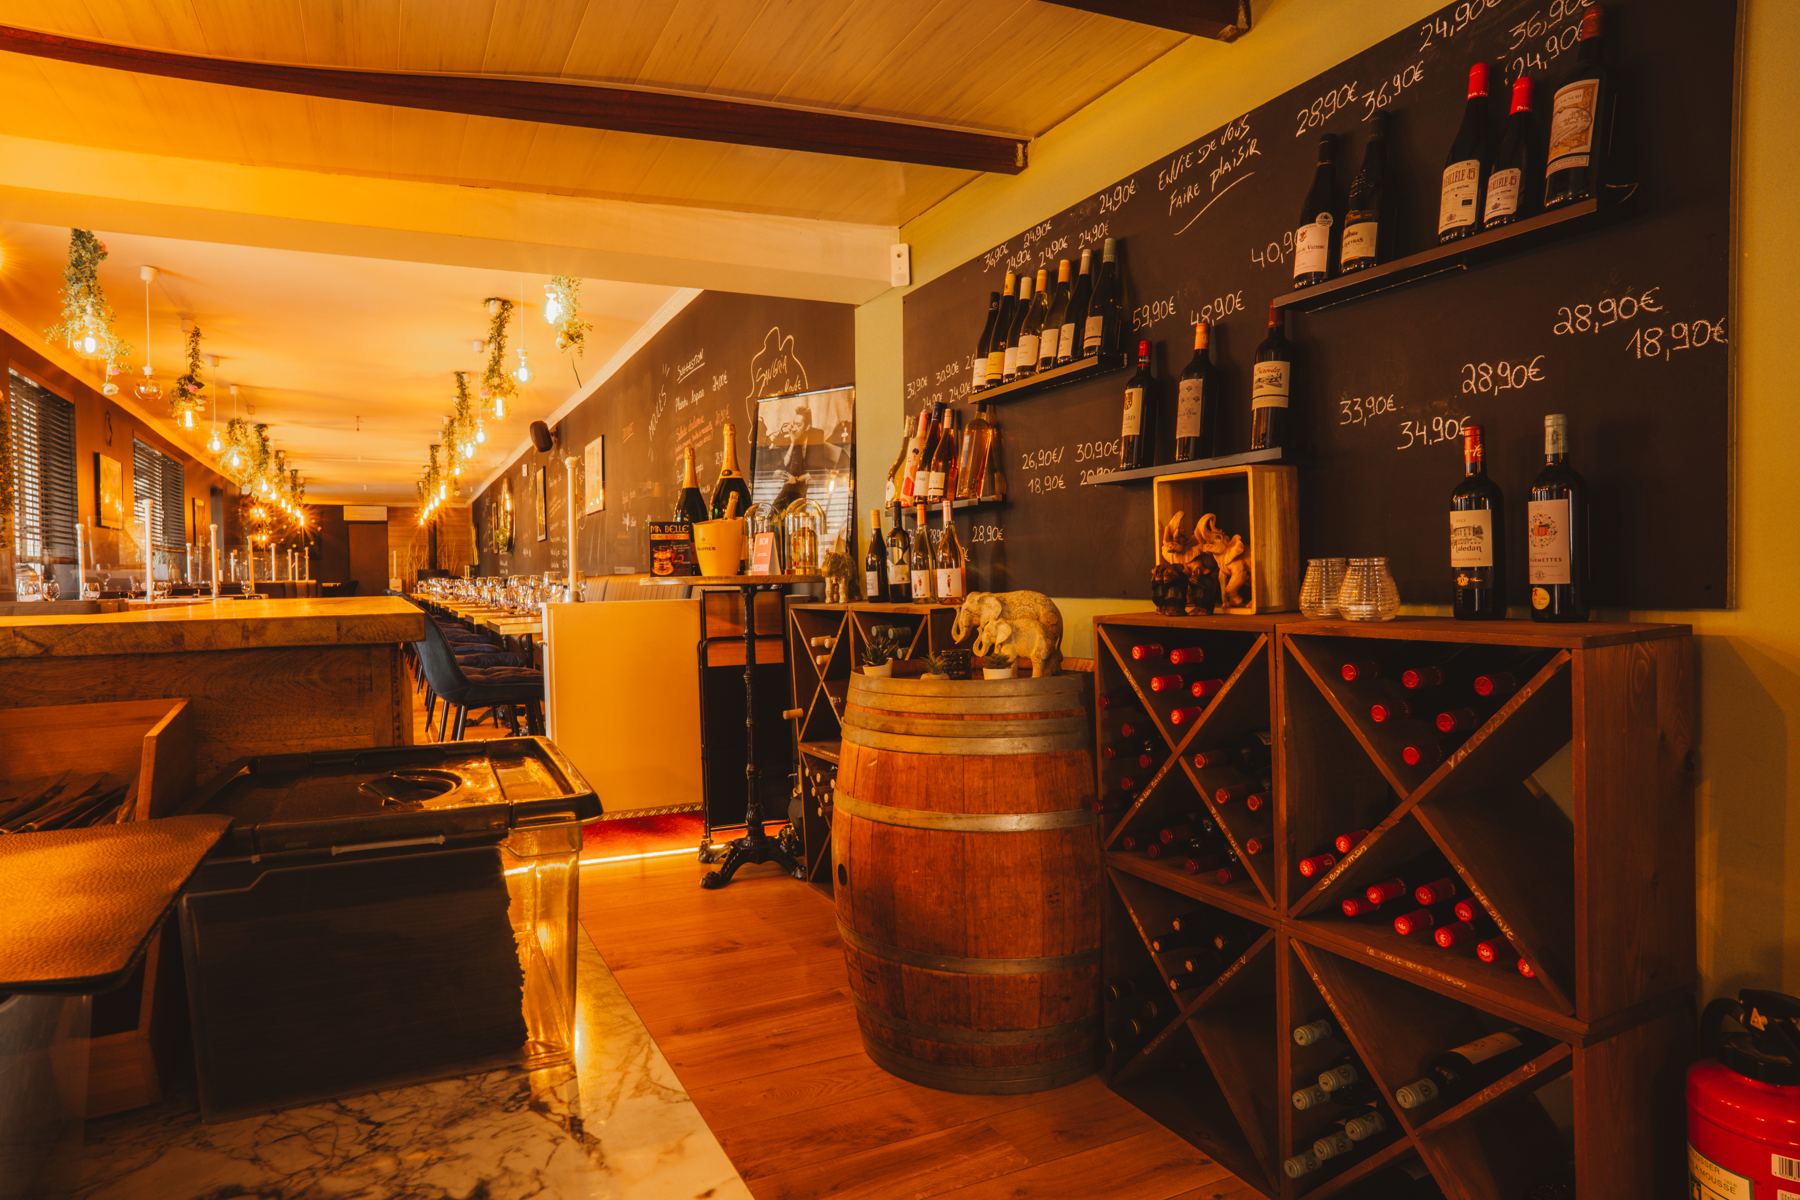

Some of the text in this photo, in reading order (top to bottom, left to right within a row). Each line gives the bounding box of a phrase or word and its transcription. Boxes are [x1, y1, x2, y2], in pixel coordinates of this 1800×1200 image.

[1508, 0, 1592, 50] 36,90
[1295, 80, 1359, 138] 28,90€
[1360, 61, 1425, 122] 36,90€
[1099, 179, 1137, 215] 24,90€
[1251, 231, 1298, 268] 40,9
[1552, 287, 1664, 337] 28,90€
[1625, 317, 1729, 361] 18,90€
[1461, 355, 1546, 396] 28,90€
[1339, 393, 1398, 426] 33,90€
[1074, 438, 1120, 463] 30,90€
[1396, 415, 1471, 450] 34,90€
[1027, 473, 1066, 495] 18,90€
[971, 524, 1004, 545] 28,90€
